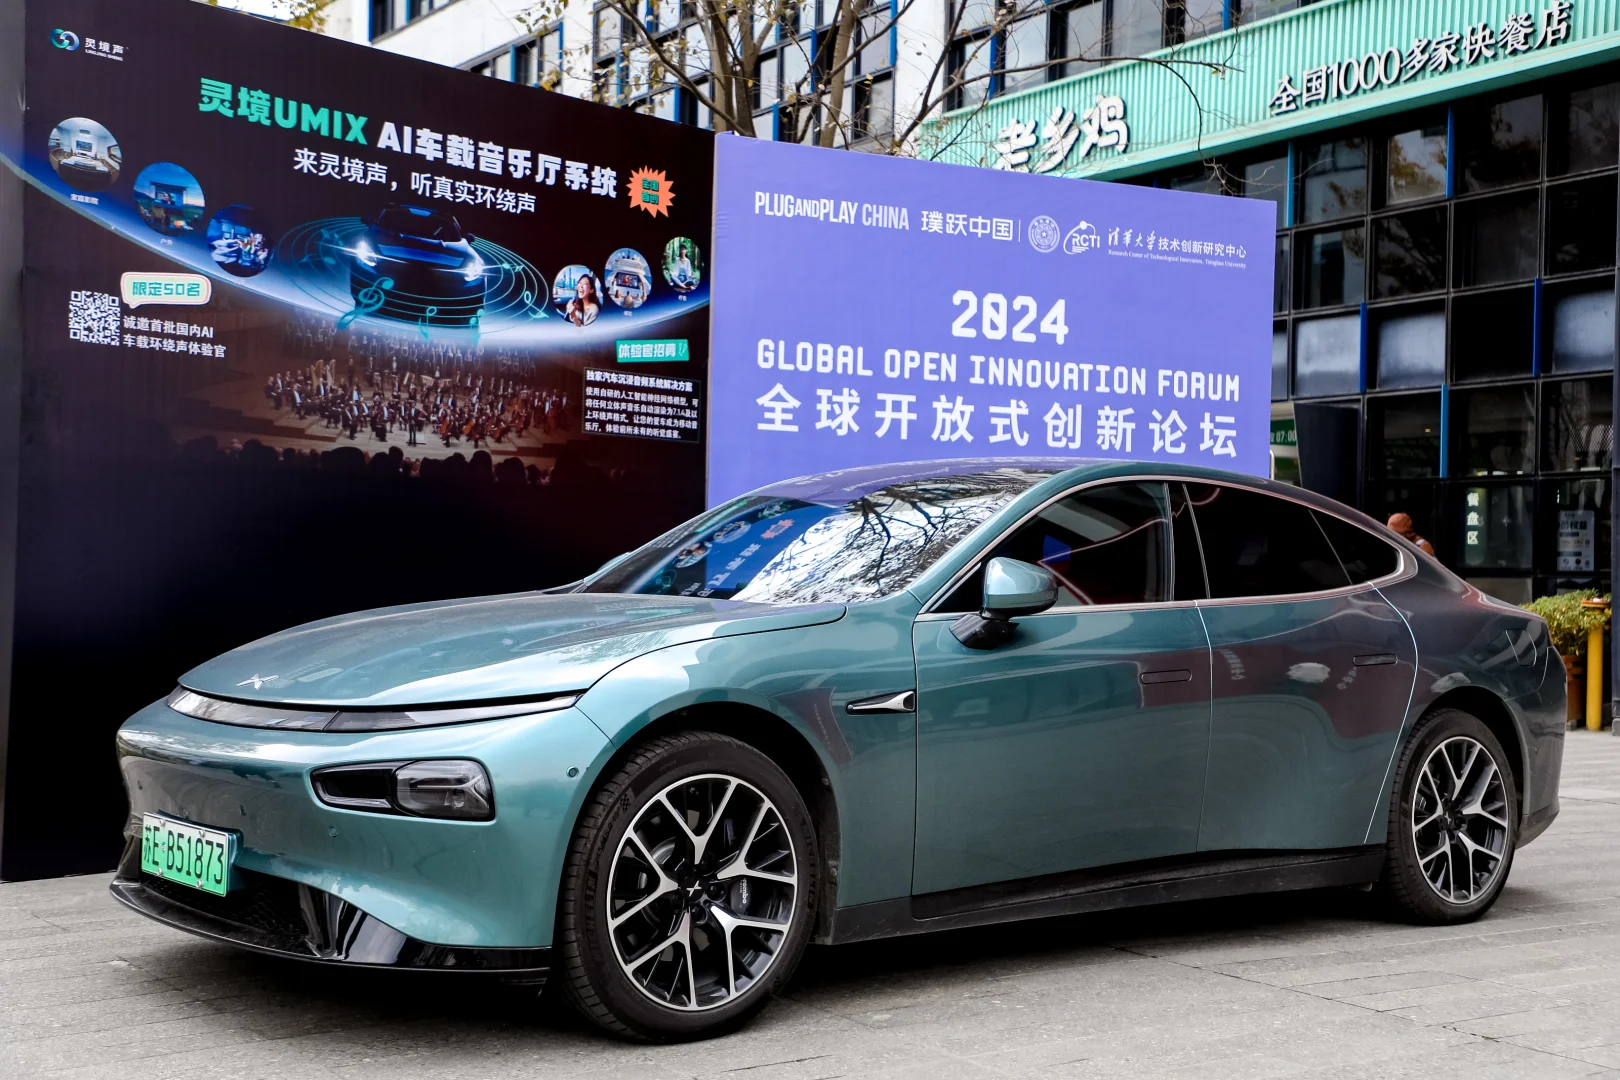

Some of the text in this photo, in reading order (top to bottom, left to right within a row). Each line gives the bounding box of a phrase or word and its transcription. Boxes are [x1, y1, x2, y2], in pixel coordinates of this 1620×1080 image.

[85, 37, 124, 54] 灵境声
[1269, 1, 1573, 116] 全国1000多家快餐店
[198, 77, 617, 199] 灵境UMIX AI车载音乐厅系统
[861, 203, 910, 231] CHINA
[920, 210, 1014, 241] 璞跃中国
[132, 281, 201, 297] 限定50名
[123, 315, 214, 338] 诚邀首批国内AI
[951, 289, 1069, 345] 2024
[122, 334, 227, 358] 车载环绕声体验官
[757, 338, 1240, 402] GLOBAL OPEN INNOVATION FORUM
[756, 382, 1237, 459] 全球开放式创新论坛
